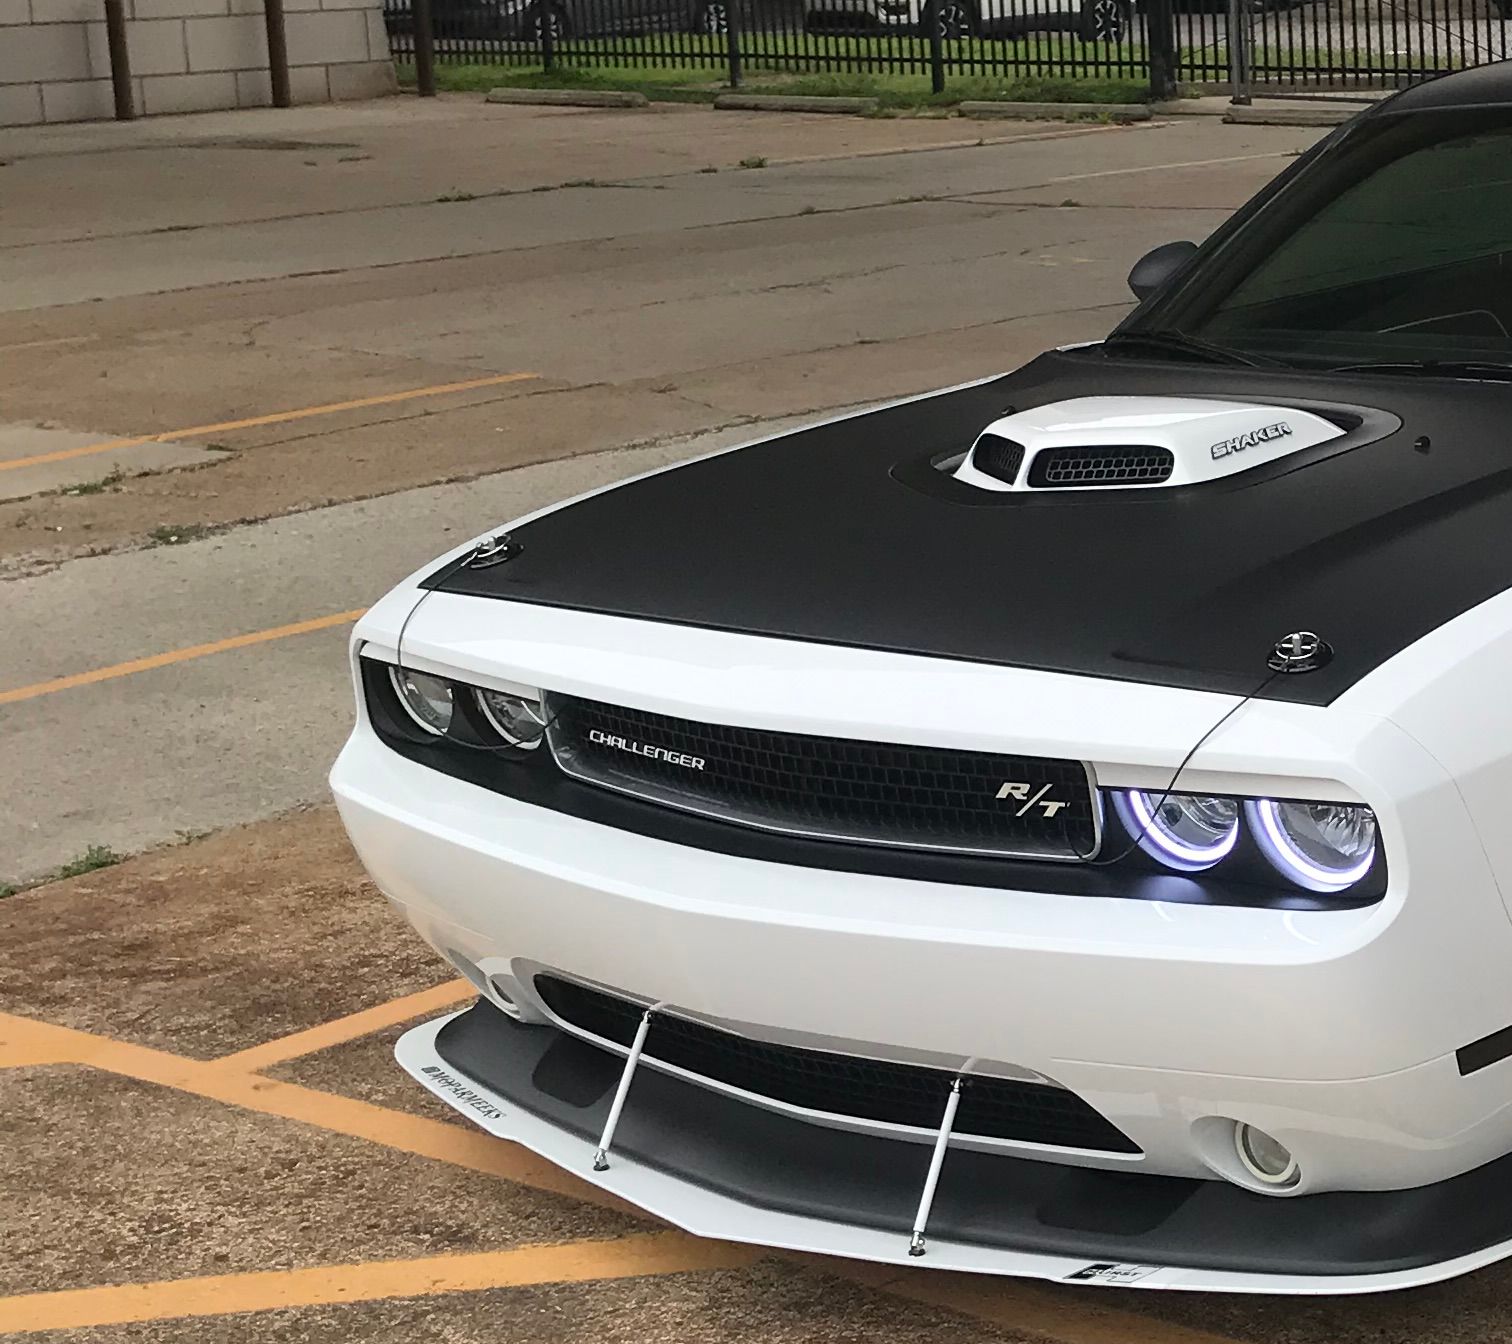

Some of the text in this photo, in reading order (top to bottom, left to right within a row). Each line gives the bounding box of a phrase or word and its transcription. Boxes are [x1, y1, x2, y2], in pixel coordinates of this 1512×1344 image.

[1210, 421, 1293, 460] SHAKER
[589, 729, 706, 770] CHALLENGER
[995, 782, 1066, 818] R/T
